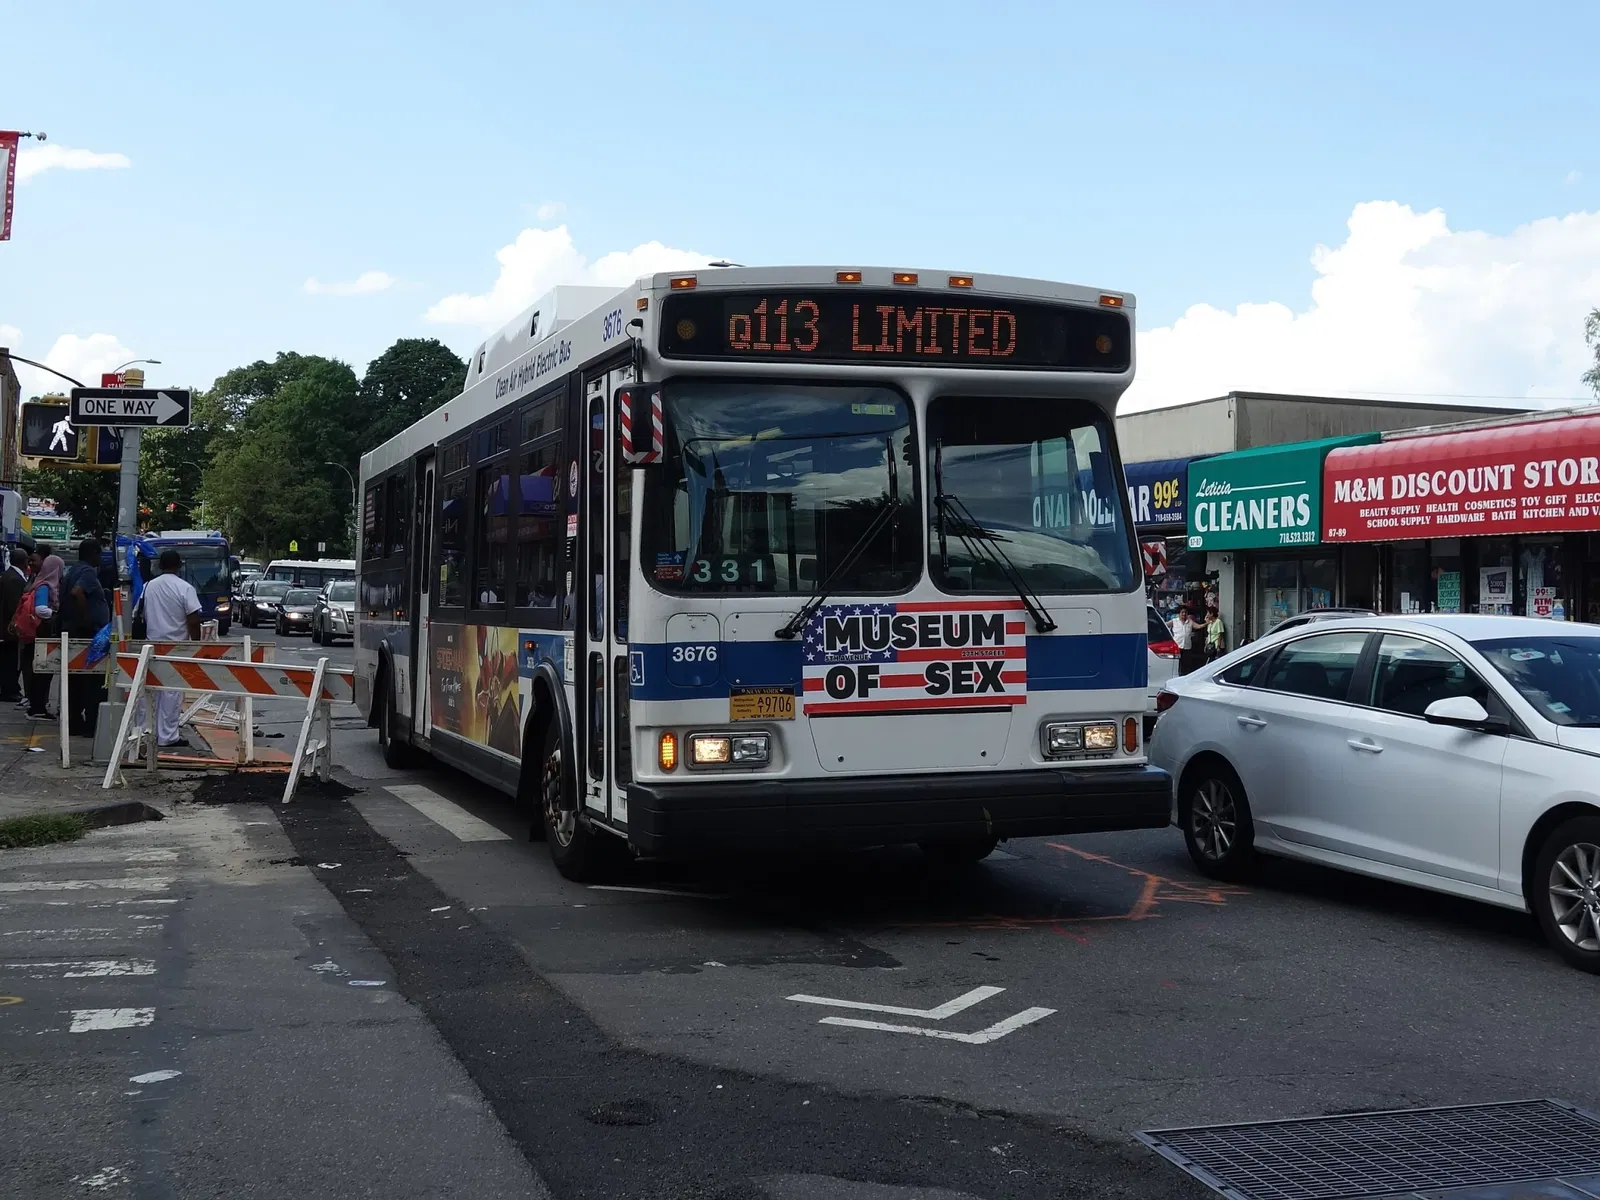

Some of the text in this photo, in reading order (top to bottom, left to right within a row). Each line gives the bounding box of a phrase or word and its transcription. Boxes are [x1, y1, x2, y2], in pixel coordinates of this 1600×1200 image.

[602, 308, 622, 342] 3676
[729, 298, 1017, 356] Q113 LIMITED
[495, 339, 572, 400] Clean Air Hybrid Electric Bus
[85, 399, 155, 415] ONE WAY
[1195, 478, 1232, 498] Leticia
[1334, 456, 1600, 504] M&M DISCOUNT STOR
[1194, 493, 1311, 533] CLEANERS
[1360, 507, 1389, 518] BEAUTY
[1390, 505, 1421, 516] SUPPLY
[1426, 502, 1459, 513] HEALTH
[1464, 498, 1517, 511] COSMETICS
[1521, 496, 1541, 507] TOY
[1545, 494, 1568, 505] GIFT
[1366, 519, 1399, 529] SCHOOL
[1400, 516, 1432, 528] SUPPLY
[1436, 512, 1485, 524] HARDWARE
[1491, 510, 1516, 521] BATH
[1523, 508, 1565, 519] KITCHEN
[1569, 506, 1590, 517] AND
[1279, 531, 1316, 544] 718.523.1312
[1328, 528, 1347, 538] 87-89
[1533, 598, 1552, 606] ATM
[824, 613, 1005, 651] MUSEUM
[672, 645, 717, 662] 3676
[840, 653, 871, 661] AVENUE
[825, 661, 1006, 700] OF SEX
[765, 696, 792, 713] 9706
